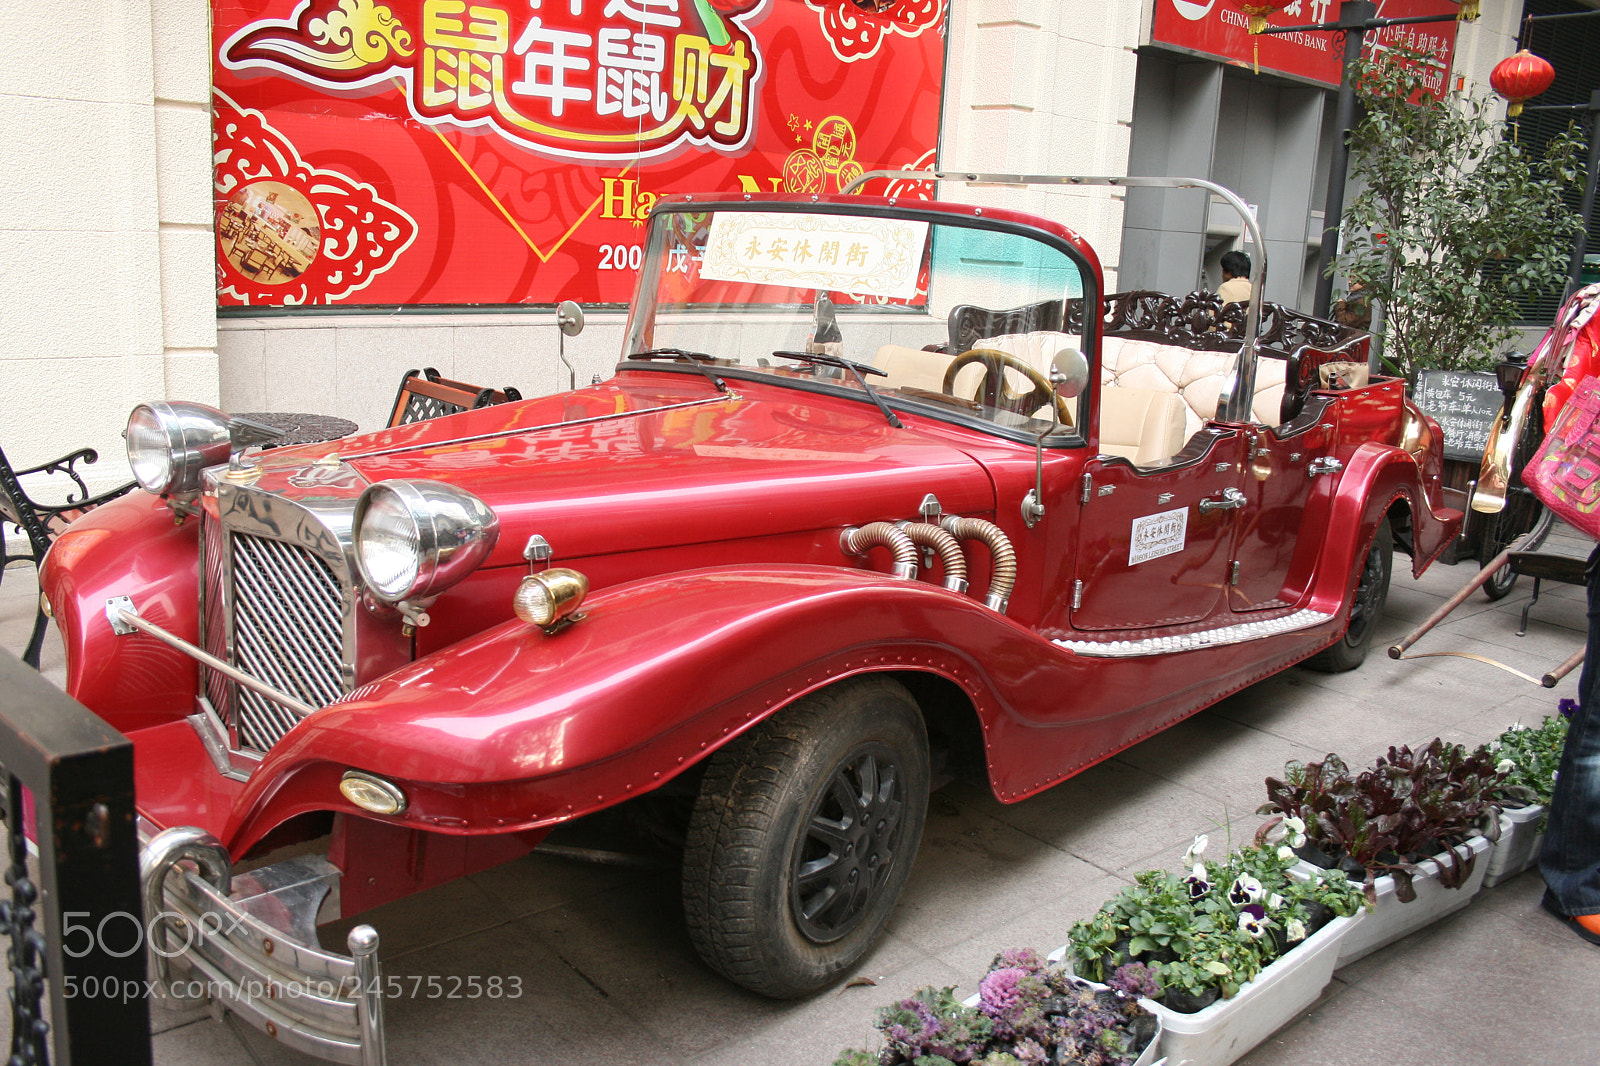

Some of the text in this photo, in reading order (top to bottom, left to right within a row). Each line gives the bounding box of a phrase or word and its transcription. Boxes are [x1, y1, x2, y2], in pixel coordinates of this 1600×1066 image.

[1220, 9, 1249, 29] CHINA
[1304, 34, 1327, 52] BANK
[1382, 24, 1448, 60] 小时自助服务
[422, 0, 752, 142] 鼠年鼠财
[599, 244, 643, 271] 200
[1458, 391, 1477, 402] 5元
